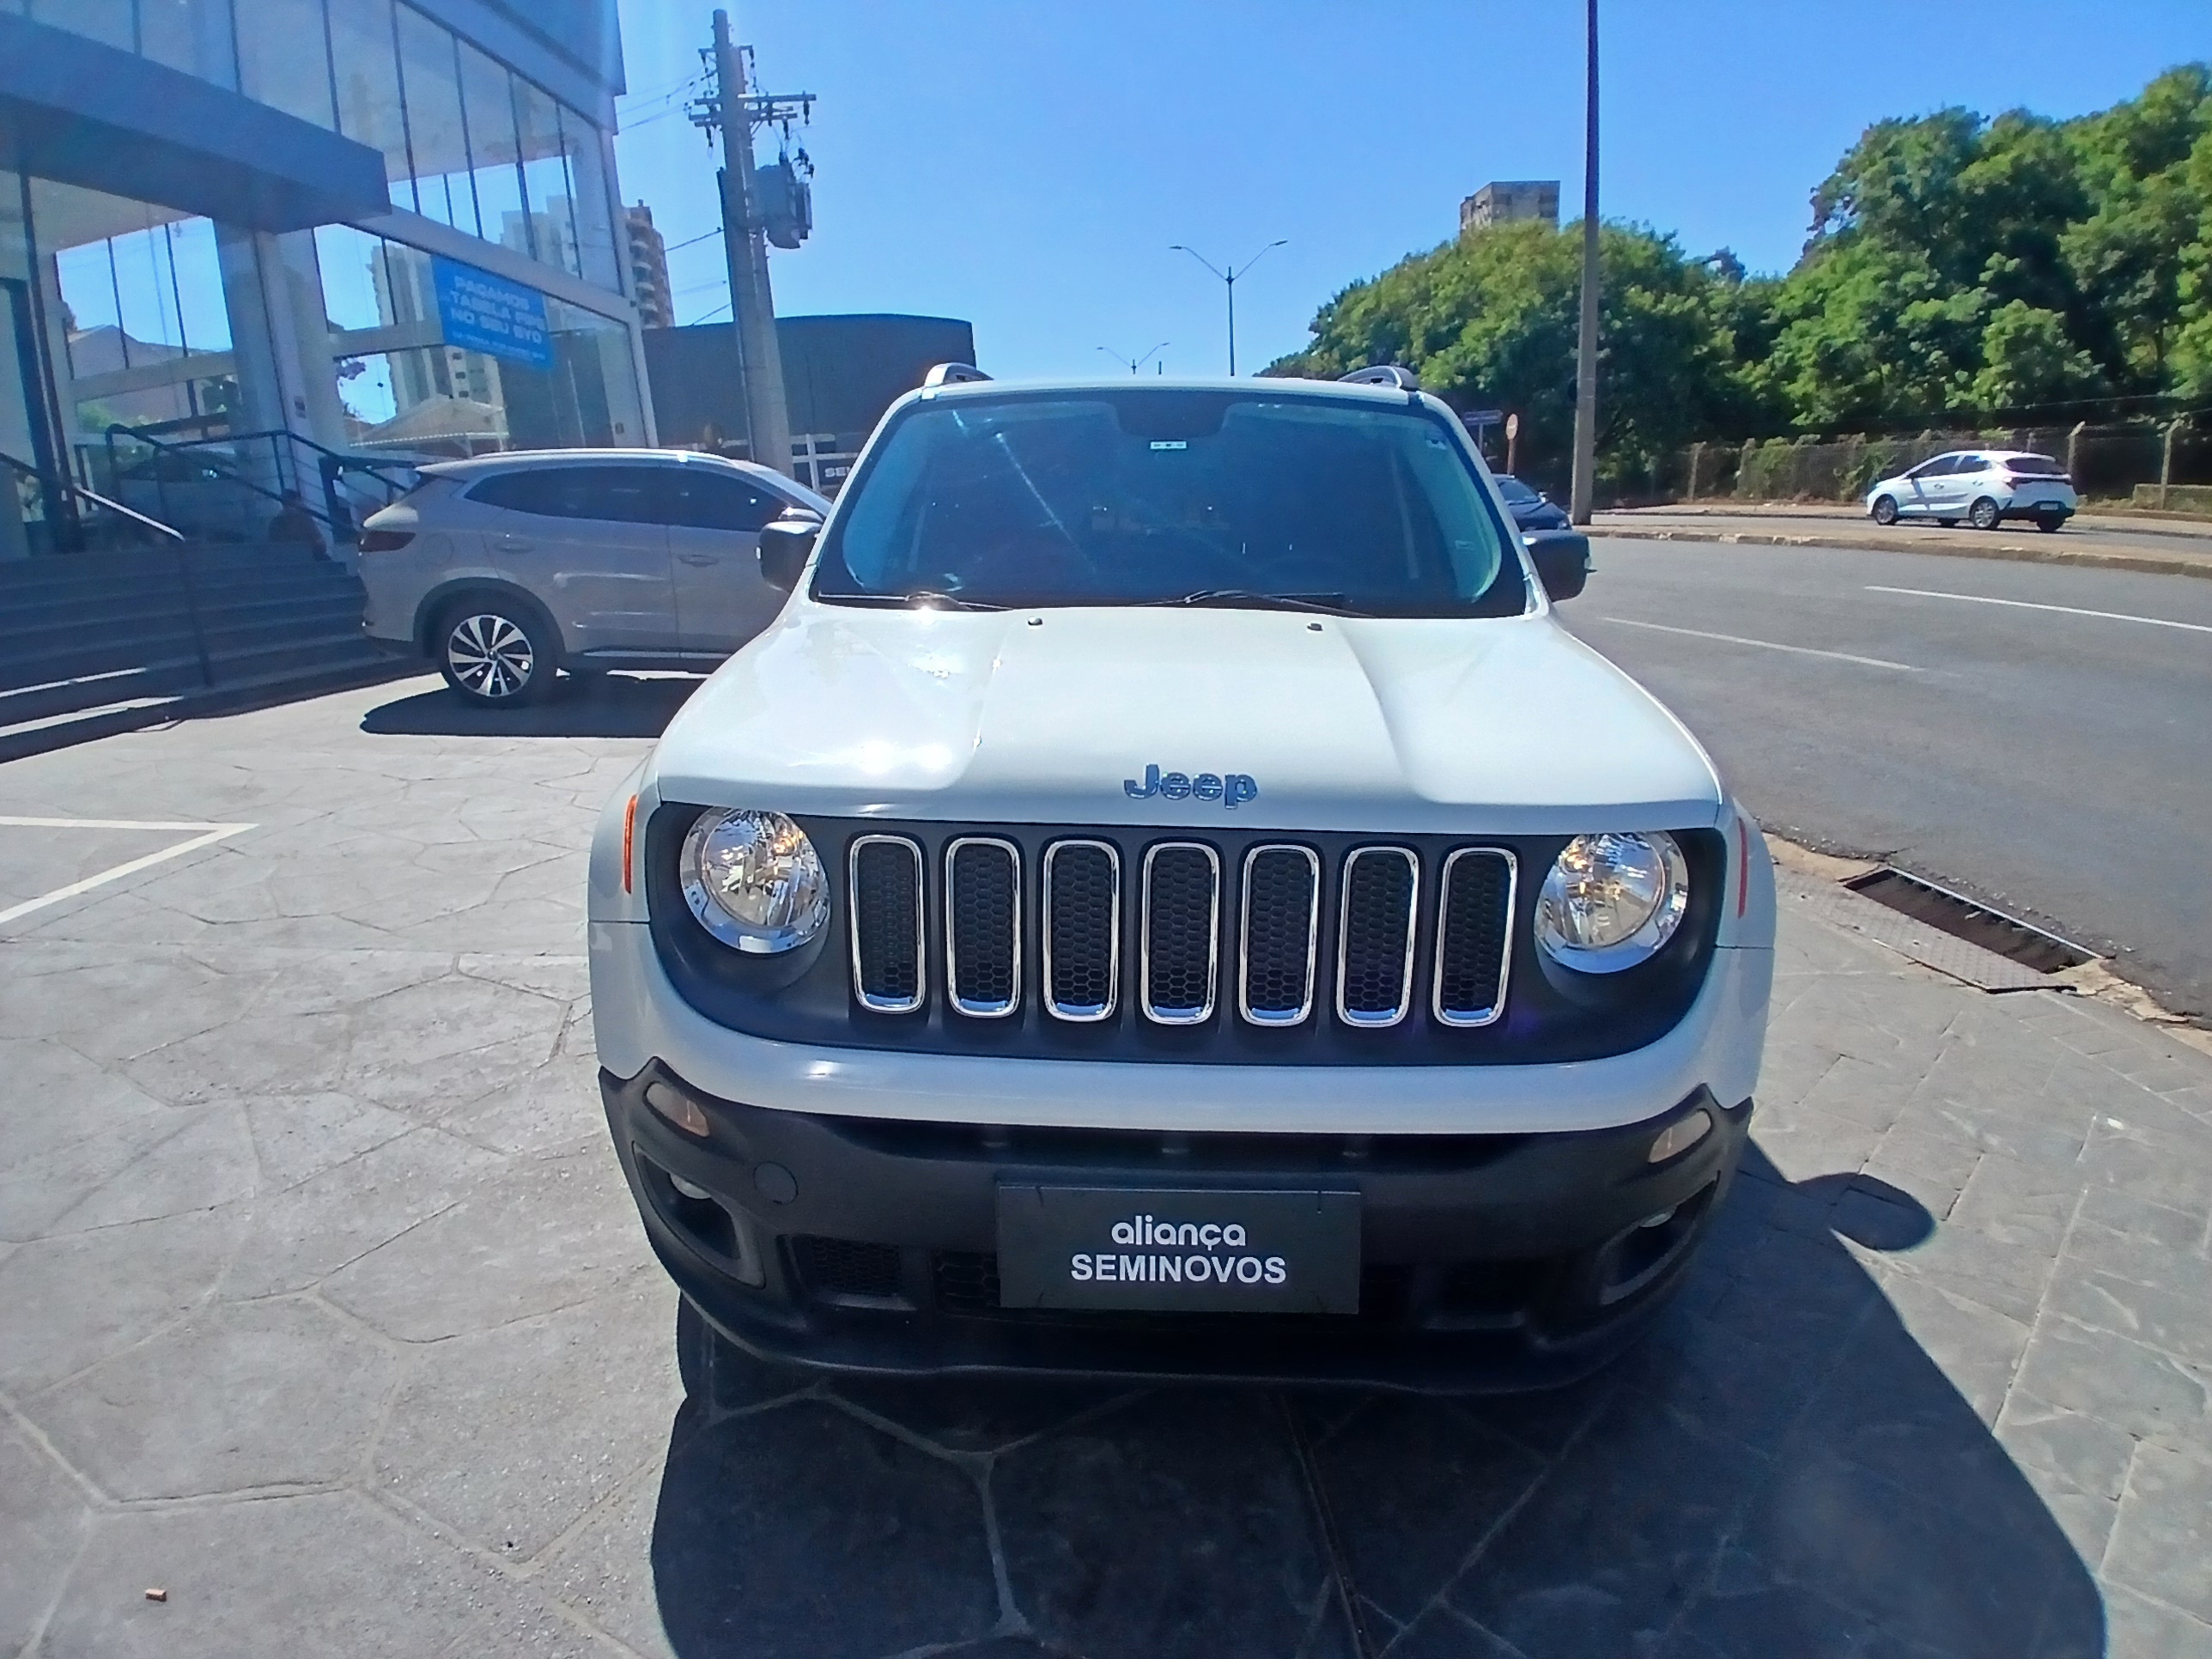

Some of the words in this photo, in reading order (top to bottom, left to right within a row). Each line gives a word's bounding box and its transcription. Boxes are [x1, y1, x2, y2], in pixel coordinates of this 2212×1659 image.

[1124, 764, 1257, 810] Jeep
[1112, 1215, 1246, 1250] aliança
[1071, 1254, 1286, 1284] SEMINOVOS
